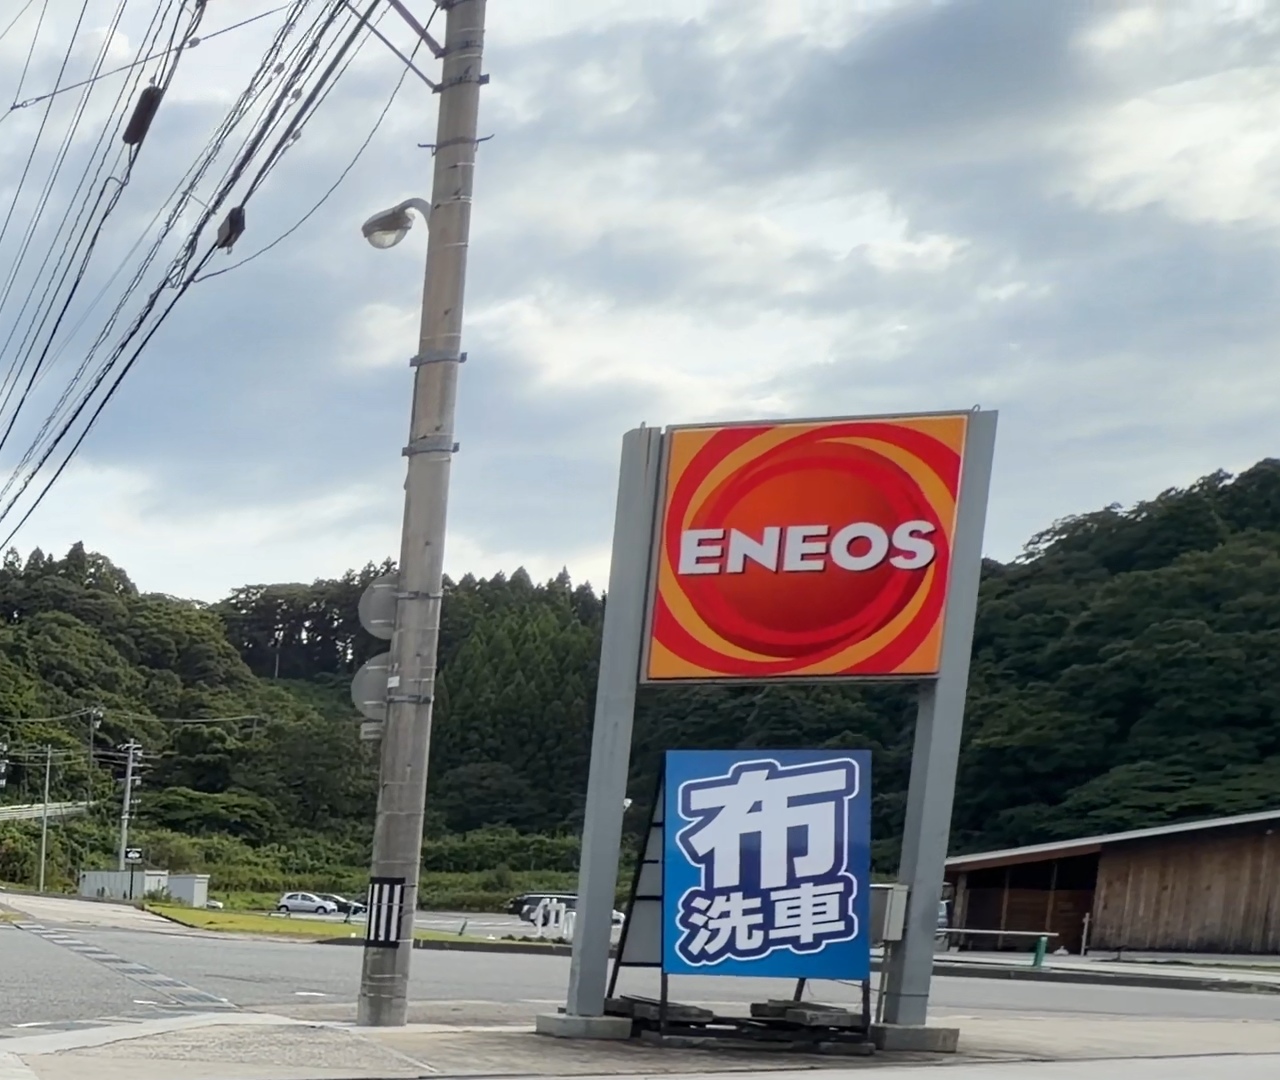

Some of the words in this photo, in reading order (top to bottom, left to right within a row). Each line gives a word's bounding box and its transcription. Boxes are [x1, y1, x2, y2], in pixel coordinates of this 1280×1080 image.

[677, 520, 937, 575] ENEOS
[682, 763, 852, 891] 布
[682, 881, 851, 960] 洗車
